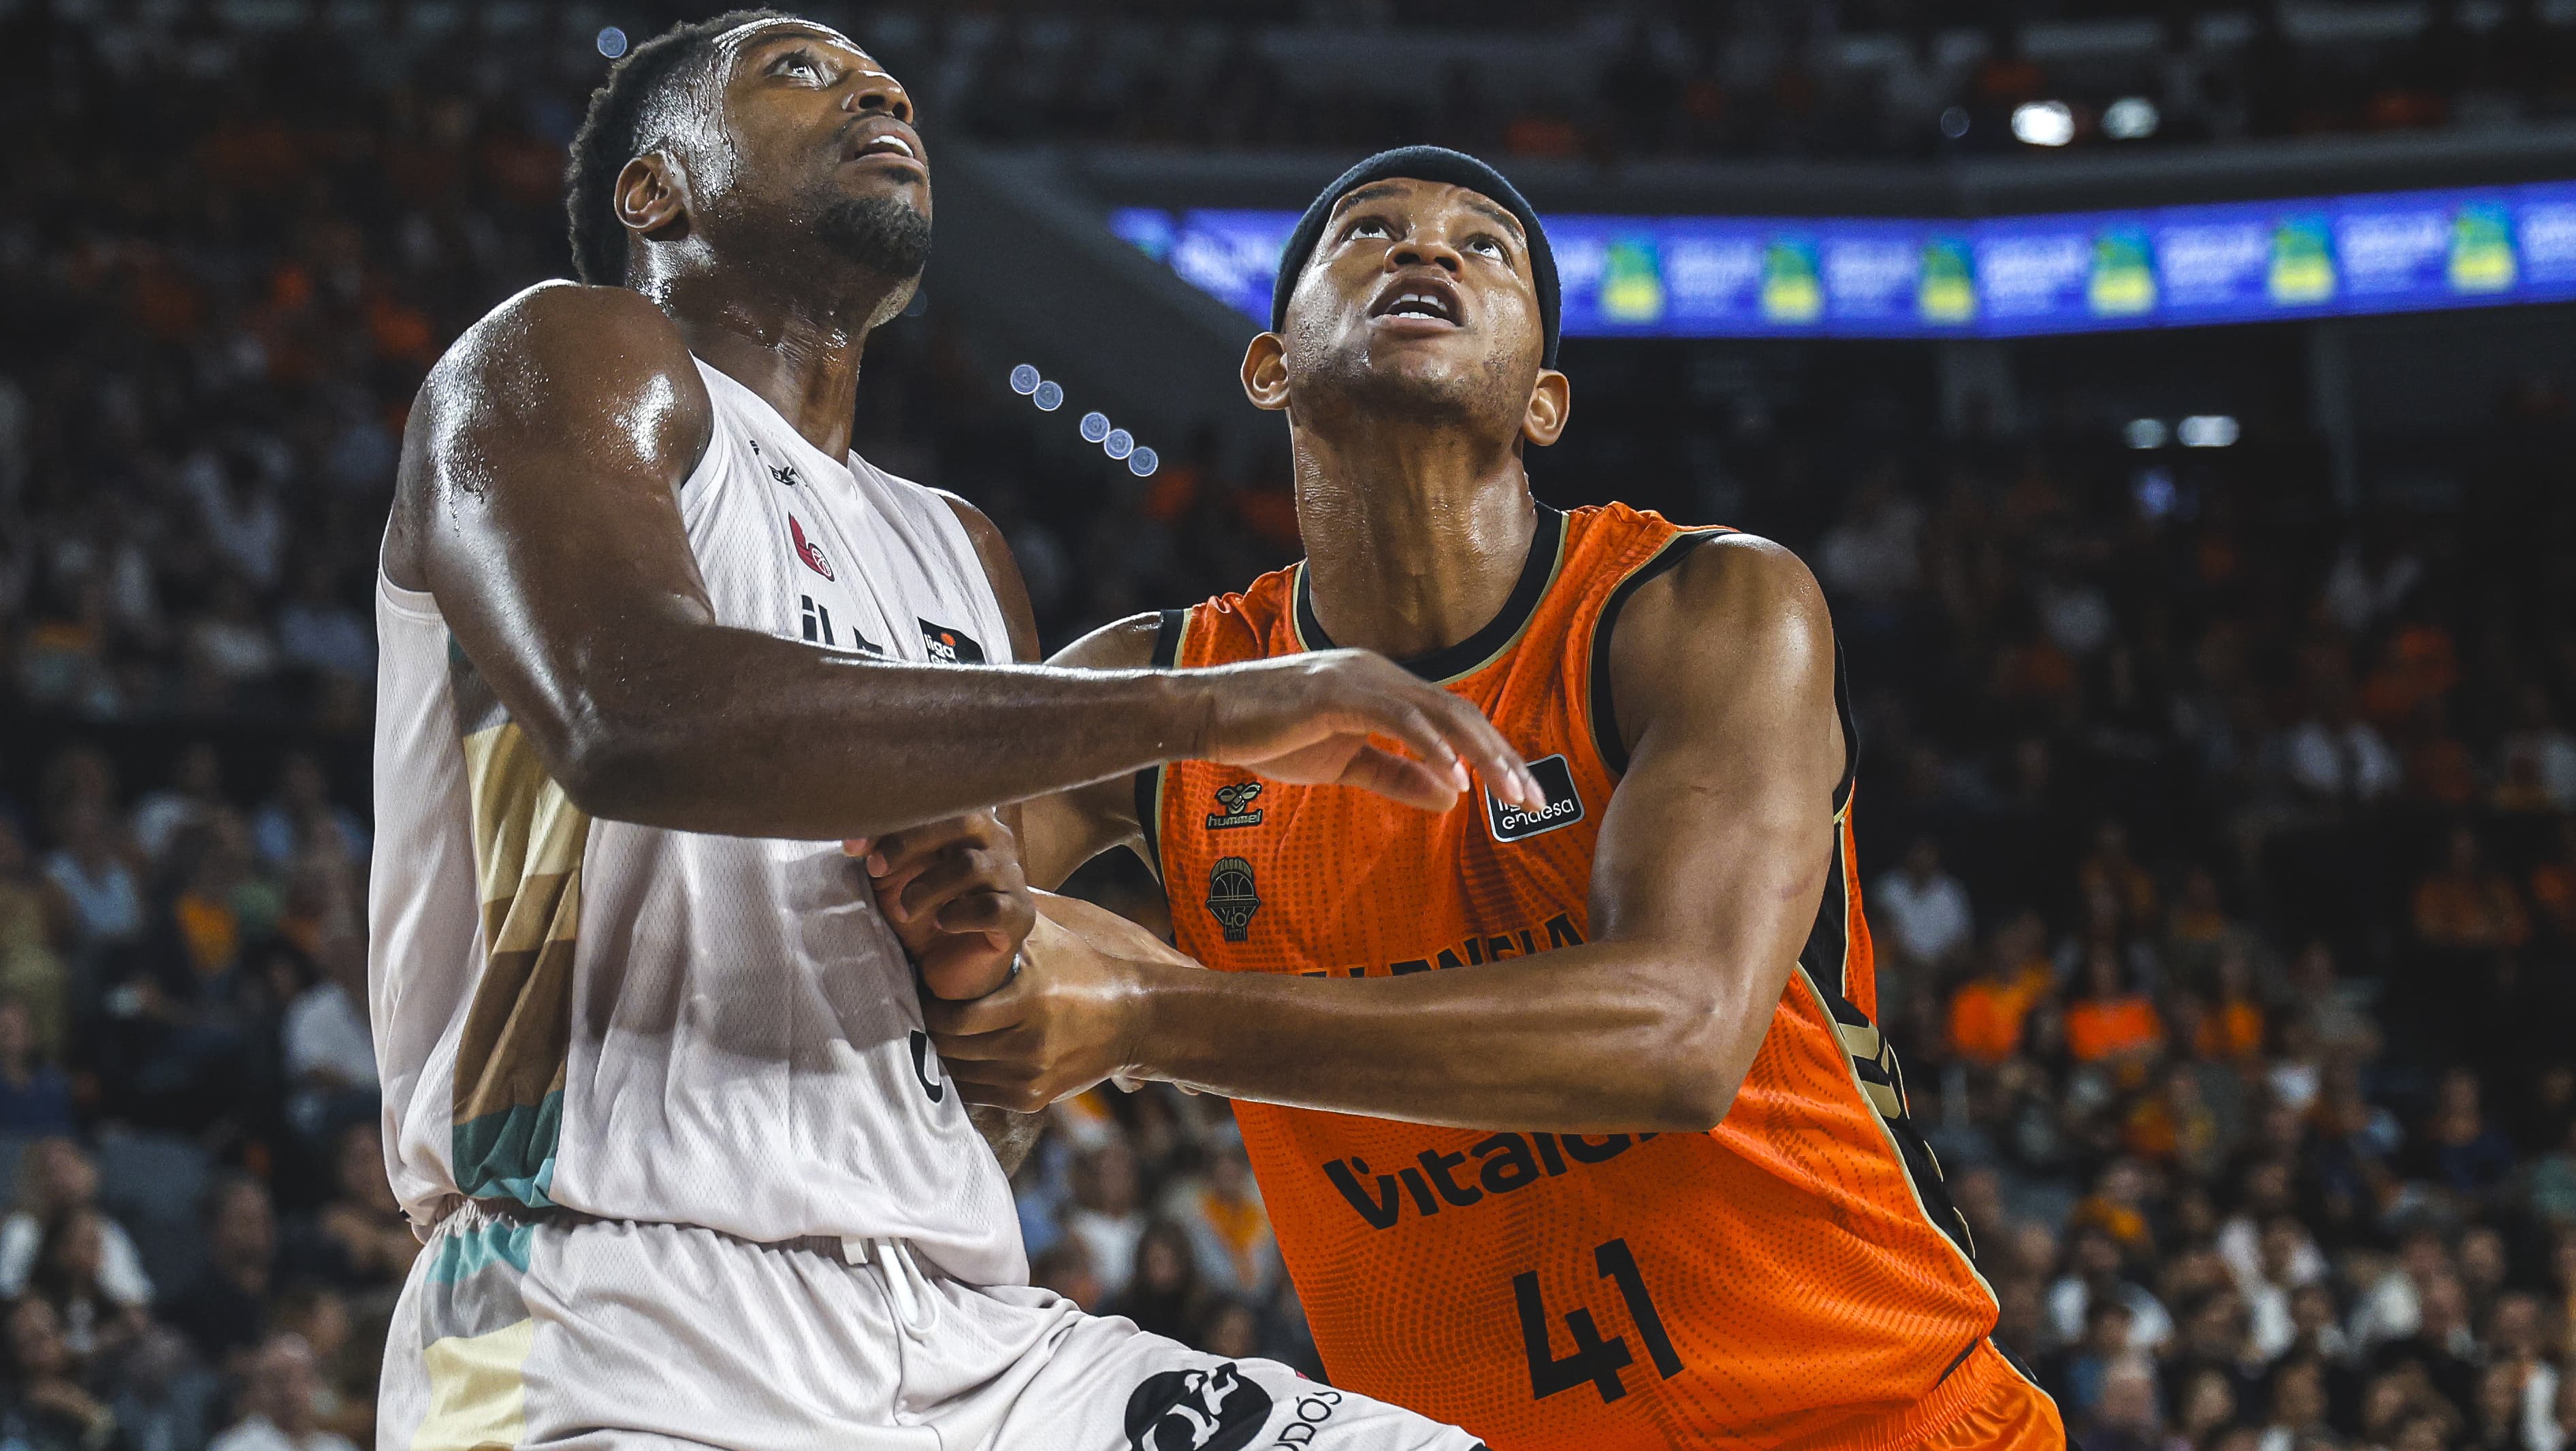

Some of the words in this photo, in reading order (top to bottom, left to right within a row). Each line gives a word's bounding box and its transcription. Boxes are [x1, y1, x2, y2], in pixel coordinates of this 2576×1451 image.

[924, 633, 956, 660] liga
[1207, 809, 1261, 828] hummel
[1513, 1238, 1684, 1405] 41
